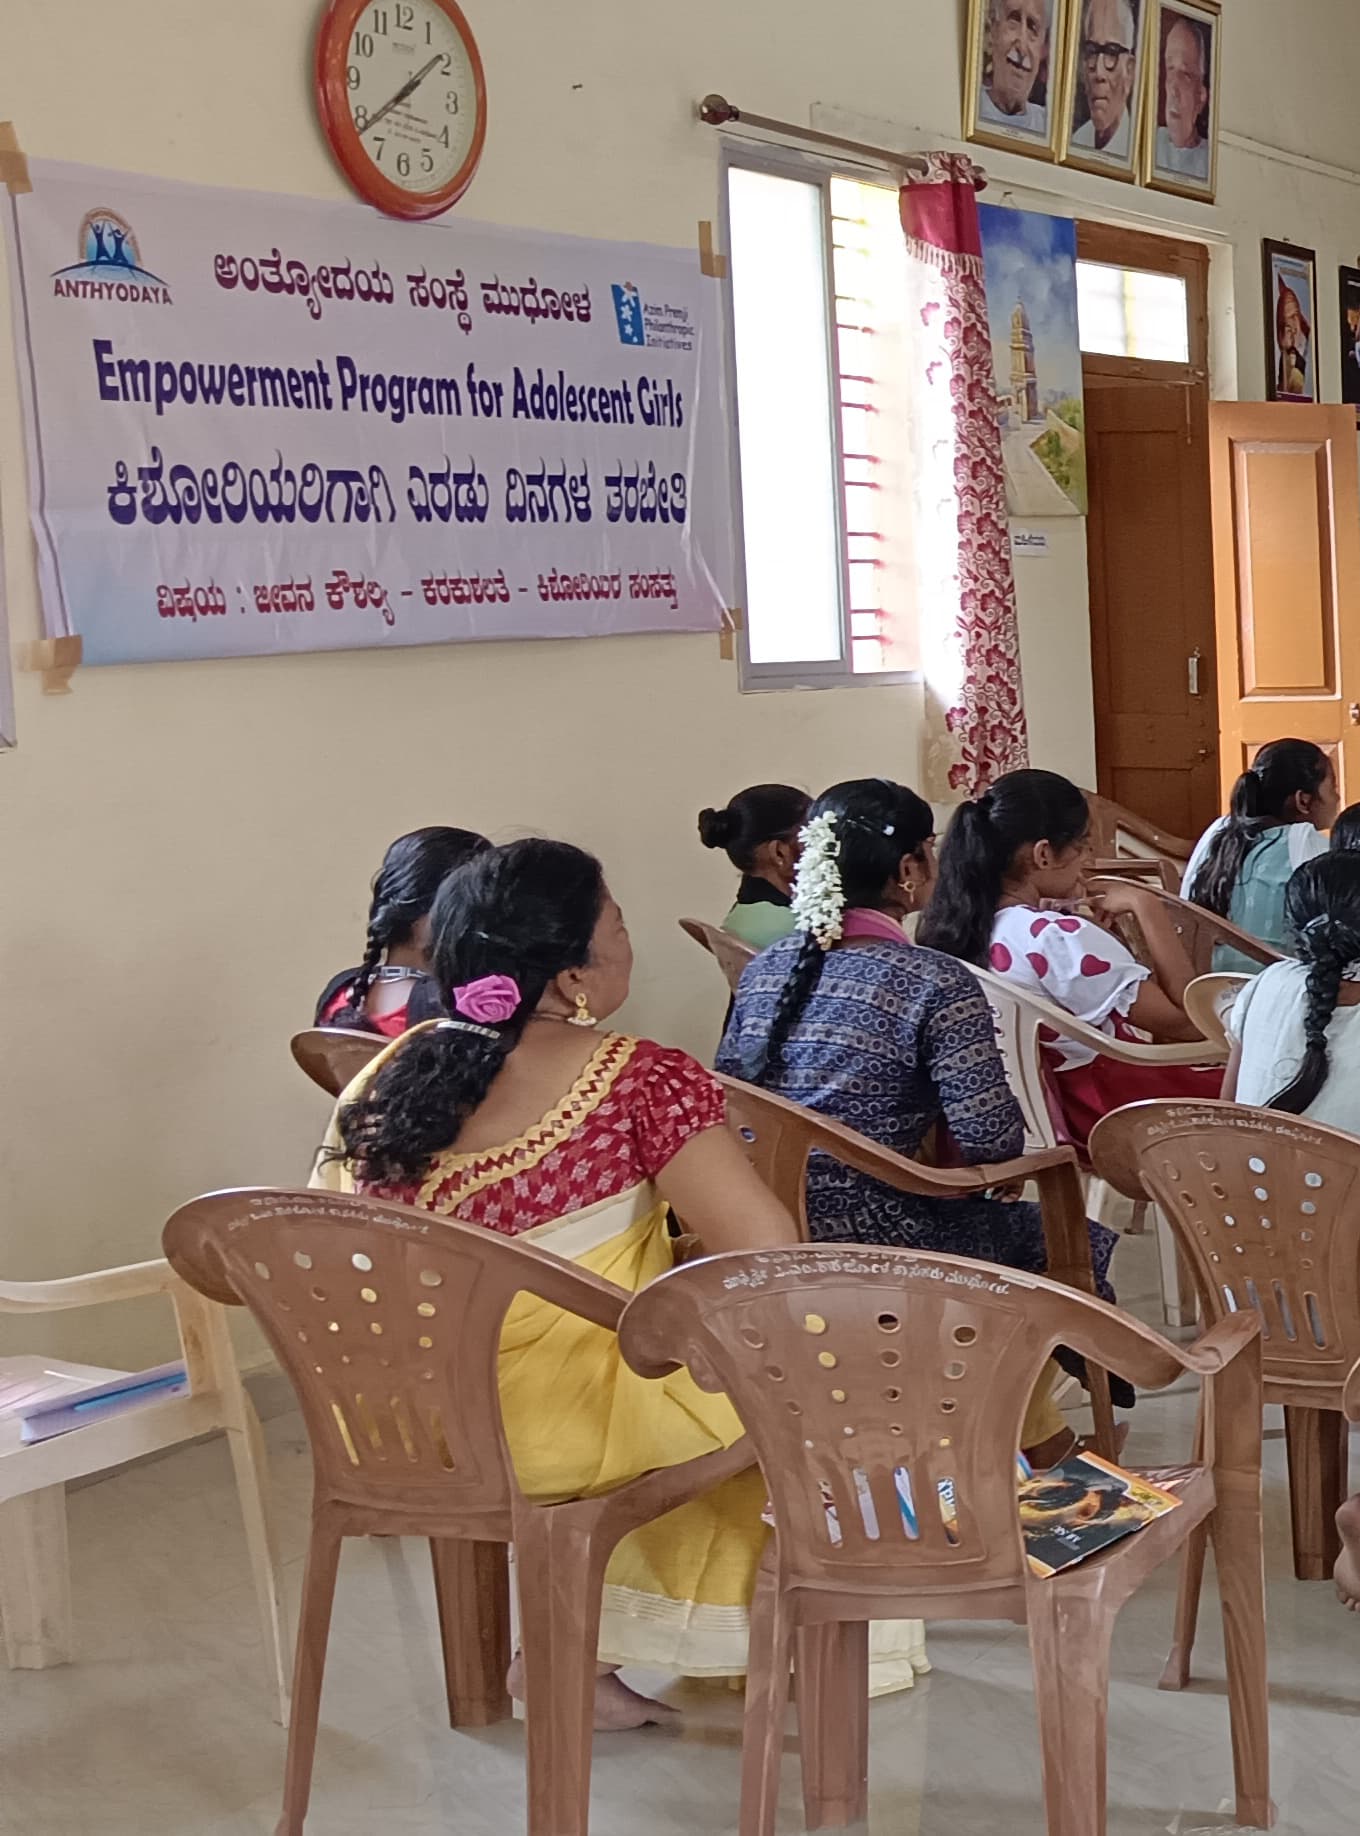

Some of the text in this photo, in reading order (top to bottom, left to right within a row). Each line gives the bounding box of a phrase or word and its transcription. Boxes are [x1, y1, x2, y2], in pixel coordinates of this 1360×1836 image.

[374, 9, 388, 36] 11
[395, 3, 414, 31] 12
[355, 31, 374, 58] 10
[425, 21, 432, 45] 1
[440, 53, 452, 76] 2
[347, 65, 360, 90] 9
[446, 91, 458, 115] 3
[355, 105, 369, 130] 8
[373, 136, 385, 161] 7
[438, 125, 449, 149] 4
[397, 153, 410, 177] 6
[420, 149, 434, 172] 5
[54, 278, 173, 305] ANTHYODAYA
[213, 247, 592, 336] ಅಂತ್ಯೋದಯ ಸಂಸ್ಥೆ ಮುಧೋಳ
[644, 304, 663, 317] Azim
[92, 338, 684, 429] Empowerment Program for Adolescent Girls
[106, 446, 687, 526] ಕಿಶೋರಿಯರಿಗಾಗಿ ಎರಡು ದಿನಗಳ ತರಬೇತಿ
[155, 577, 227, 623] ವಿಷಯ
[252, 573, 316, 614] ಜೀವನ
[324, 569, 396, 627] ಕೌಶಲ್ಯ
[420, 568, 512, 606] ಕರಕುಶಲತೆ
